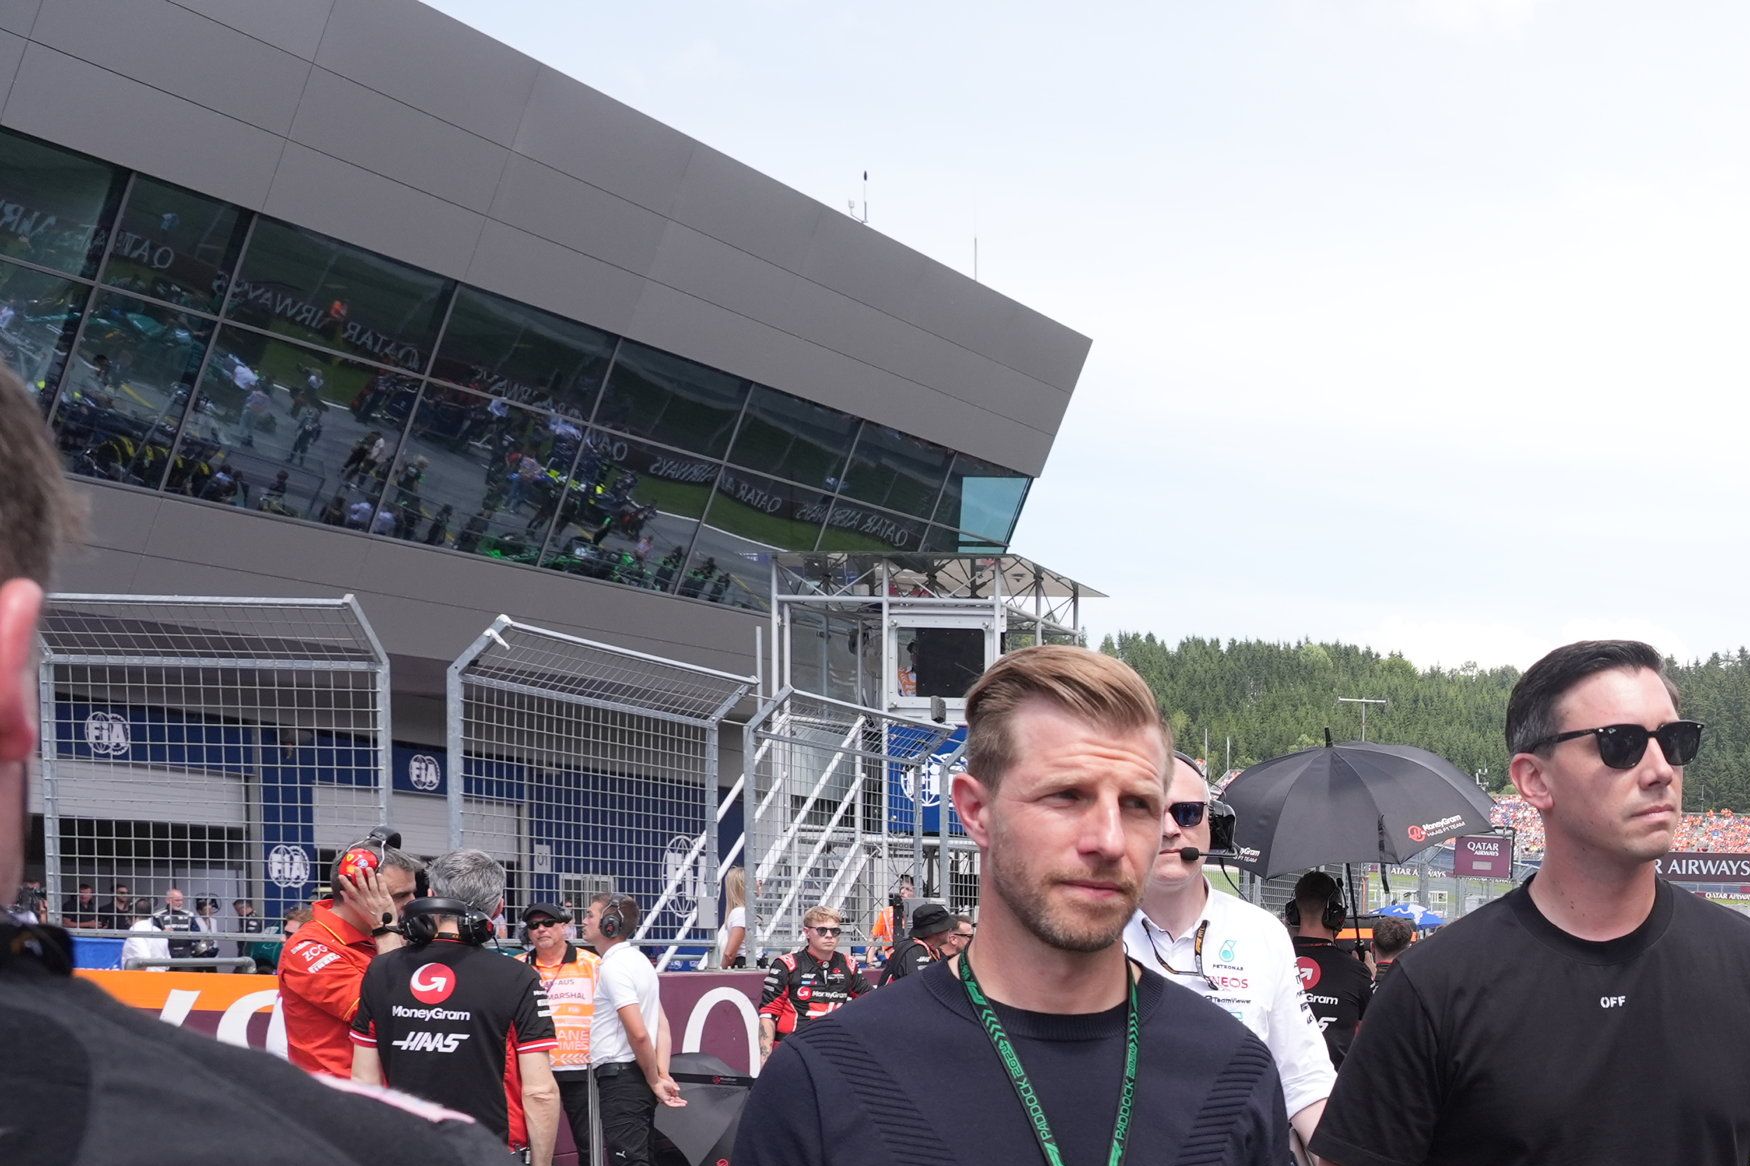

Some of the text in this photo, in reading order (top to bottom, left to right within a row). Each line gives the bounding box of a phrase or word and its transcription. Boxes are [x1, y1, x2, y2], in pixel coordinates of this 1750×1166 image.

[1422, 814, 1462, 831] MoneyGram
[1467, 841, 1499, 852] QATAR
[1705, 891, 1728, 899] QATAR
[1305, 993, 1339, 1005] Gram
[1600, 995, 1626, 1008] OFF
[392, 1005, 471, 1021] MoneyGram
[392, 1031, 470, 1053] HAAS
[1017, 1076, 1052, 1141] PADDOCK
[1115, 1080, 1135, 1141] PADDOCK
